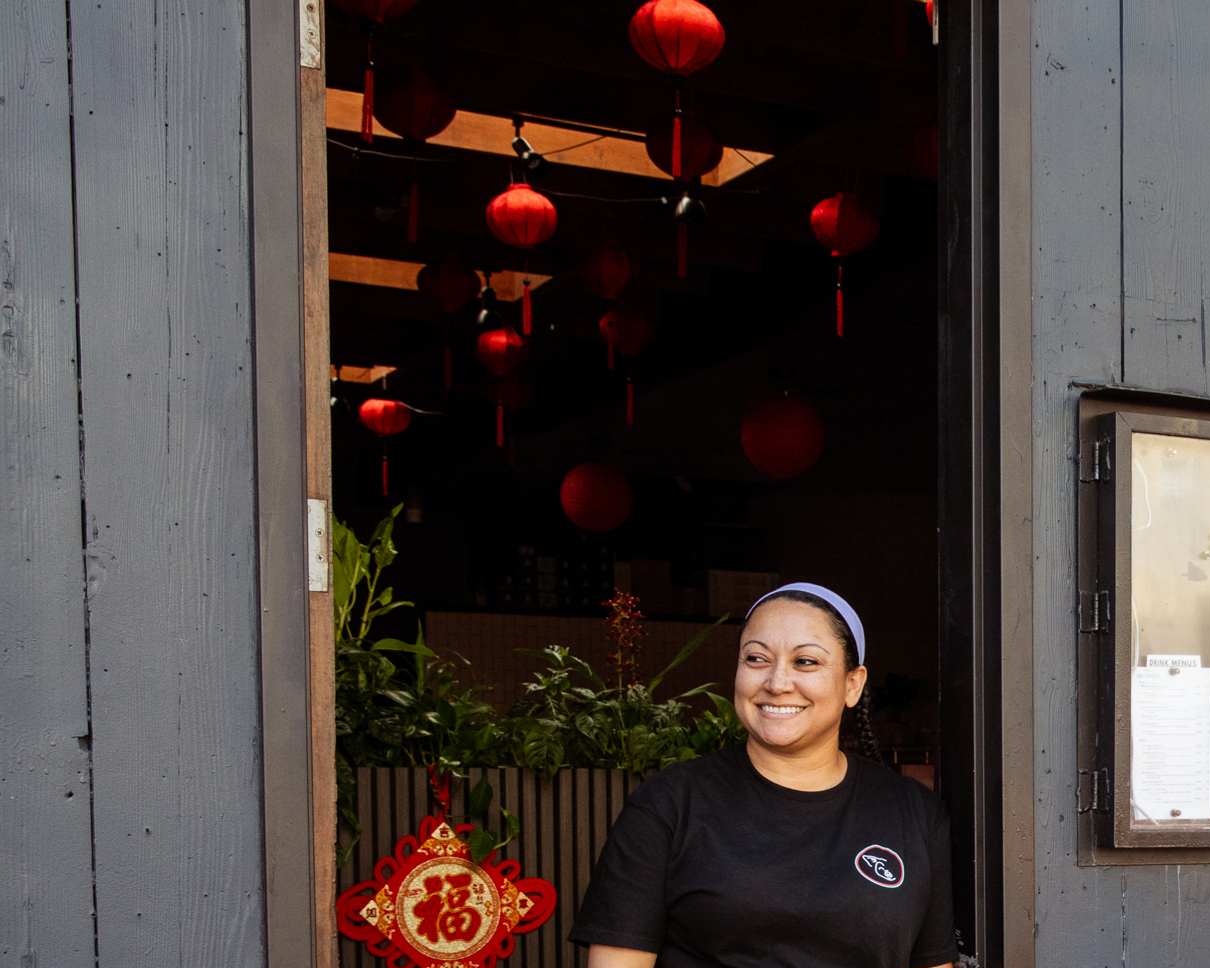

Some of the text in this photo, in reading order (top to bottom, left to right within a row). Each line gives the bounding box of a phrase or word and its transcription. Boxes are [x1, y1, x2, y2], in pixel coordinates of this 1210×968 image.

[1149, 659, 1197, 667] DRINK MENUS
[413, 873, 482, 943] 福
